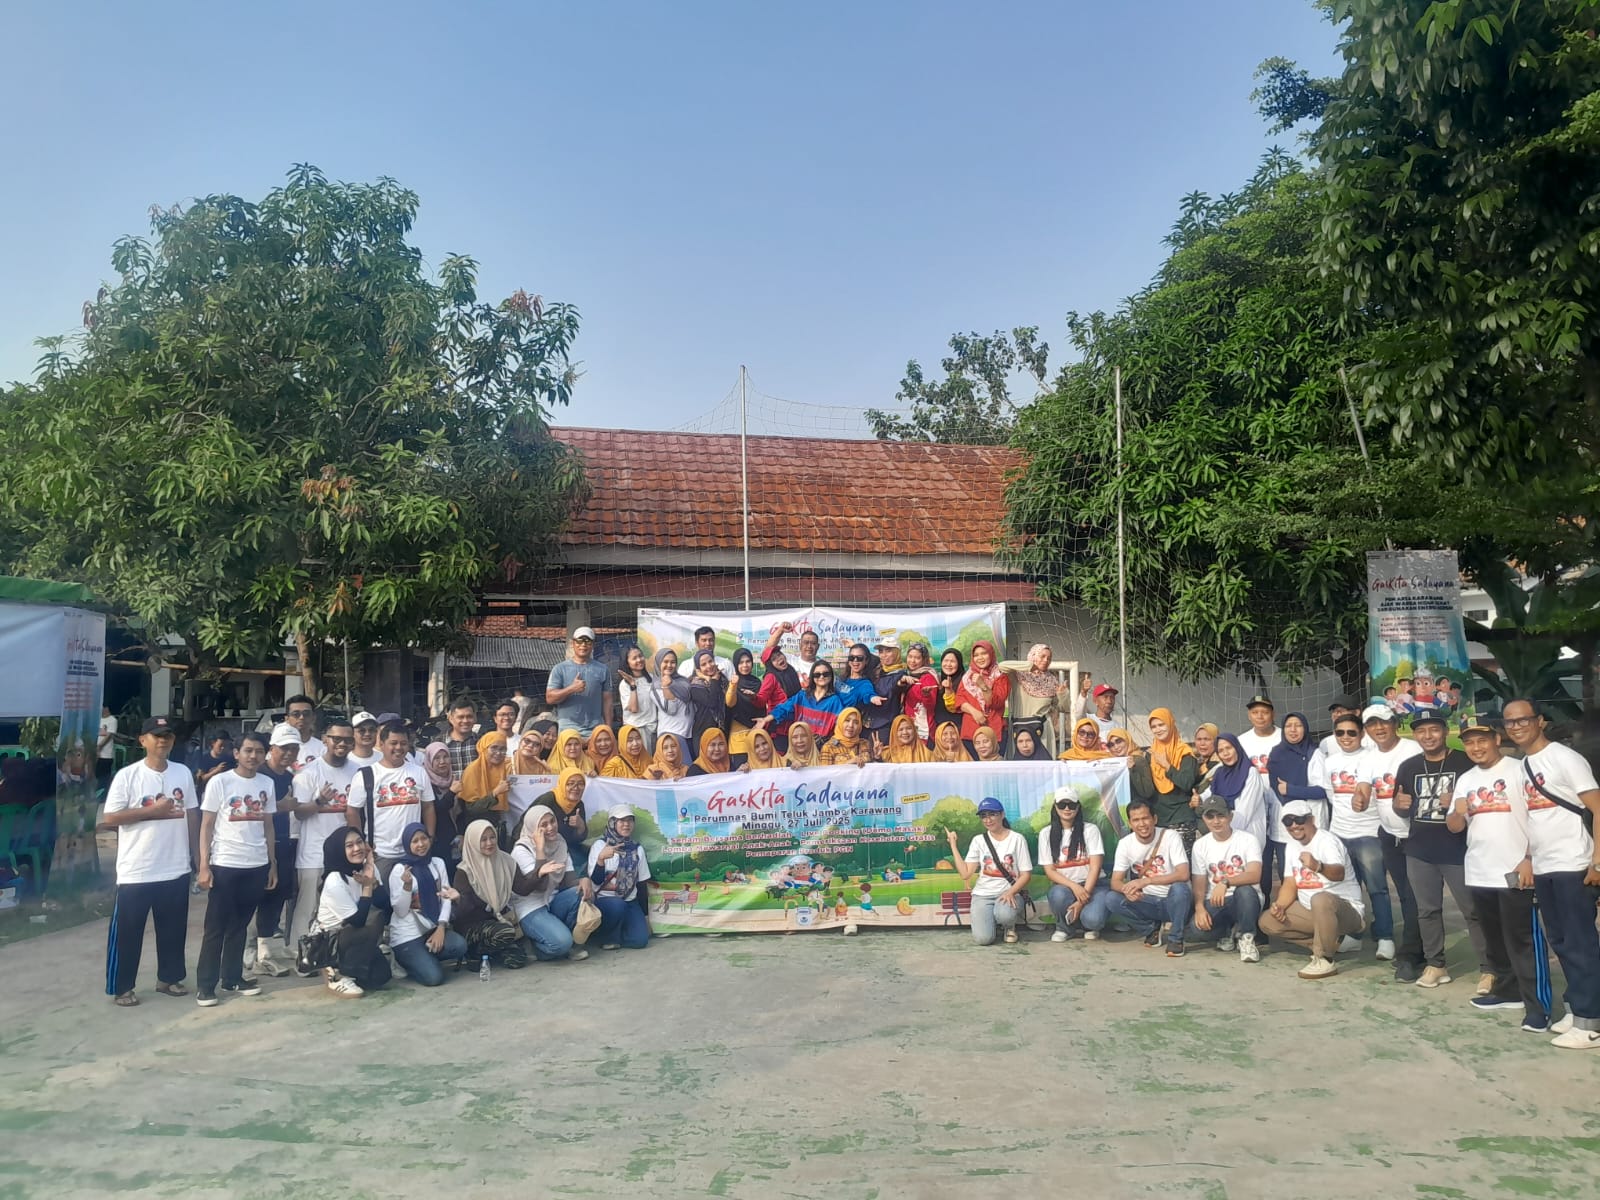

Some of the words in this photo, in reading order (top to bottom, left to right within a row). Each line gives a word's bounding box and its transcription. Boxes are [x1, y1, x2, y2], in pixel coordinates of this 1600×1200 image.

[818, 619, 872, 635] Sadayana
[707, 782, 785, 814] GasKita
[794, 781, 889, 807] Sadayana
[694, 814, 747, 823] Perumnas
[751, 811, 777, 821] Bumi
[781, 808, 808, 818] Teluk
[851, 806, 902, 816] Karawang
[742, 821, 784, 831] Minggu,
[788, 820, 799, 828] 27
[803, 818, 822, 827] Juli
[826, 817, 850, 826] 2025
